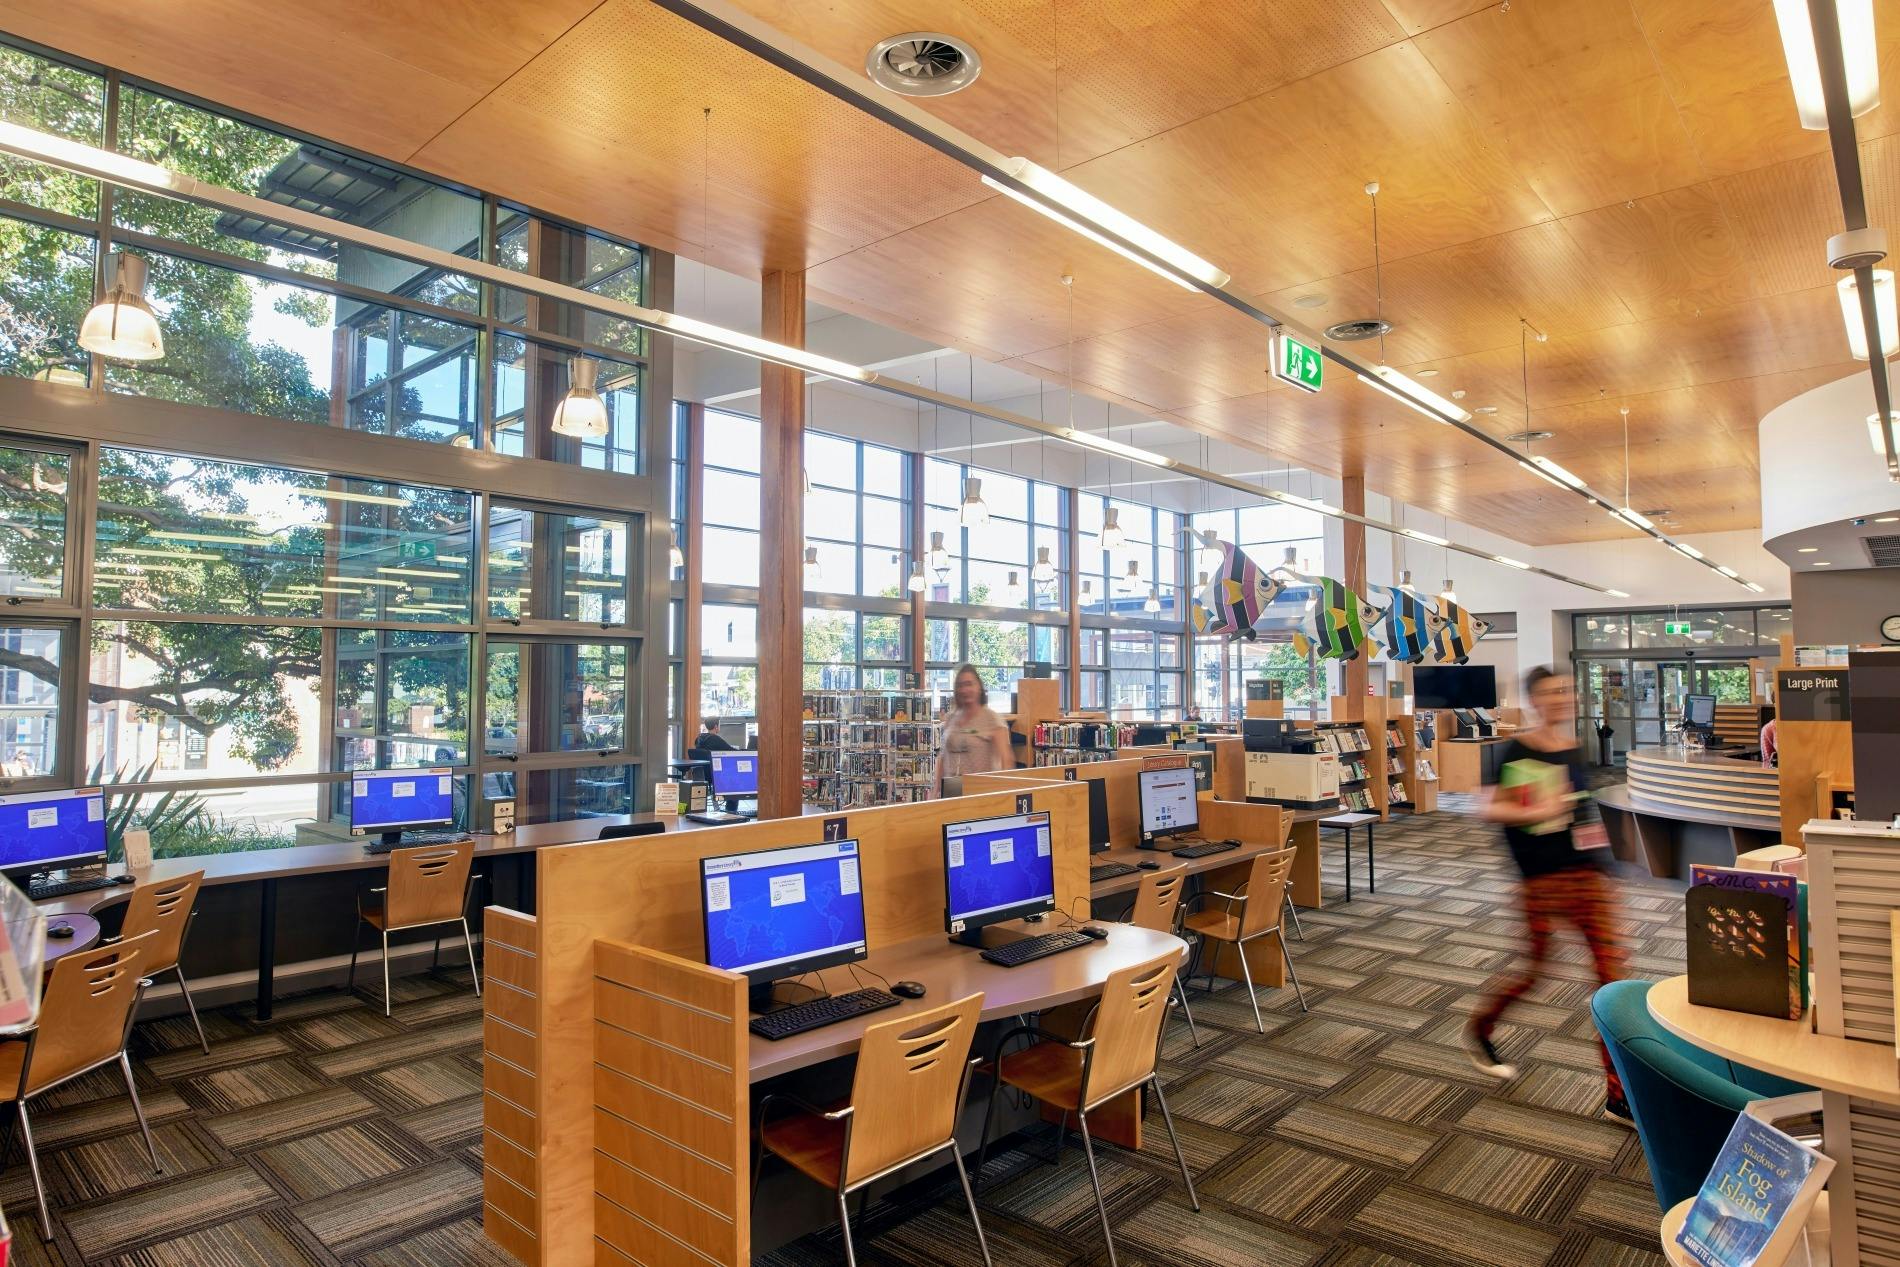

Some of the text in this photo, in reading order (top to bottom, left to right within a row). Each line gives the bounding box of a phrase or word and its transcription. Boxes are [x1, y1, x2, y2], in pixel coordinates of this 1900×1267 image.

[1787, 677, 1839, 691] Large Print
[1022, 799, 1028, 814] 8
[832, 823, 839, 840] 7
[1742, 1143, 1777, 1171] Shadow
[1776, 1167, 1791, 1179] of
[1736, 1158, 1773, 1200] Fog
[1717, 1173, 1772, 1221] Island
[1683, 1235, 1710, 1261] MARIETTE
